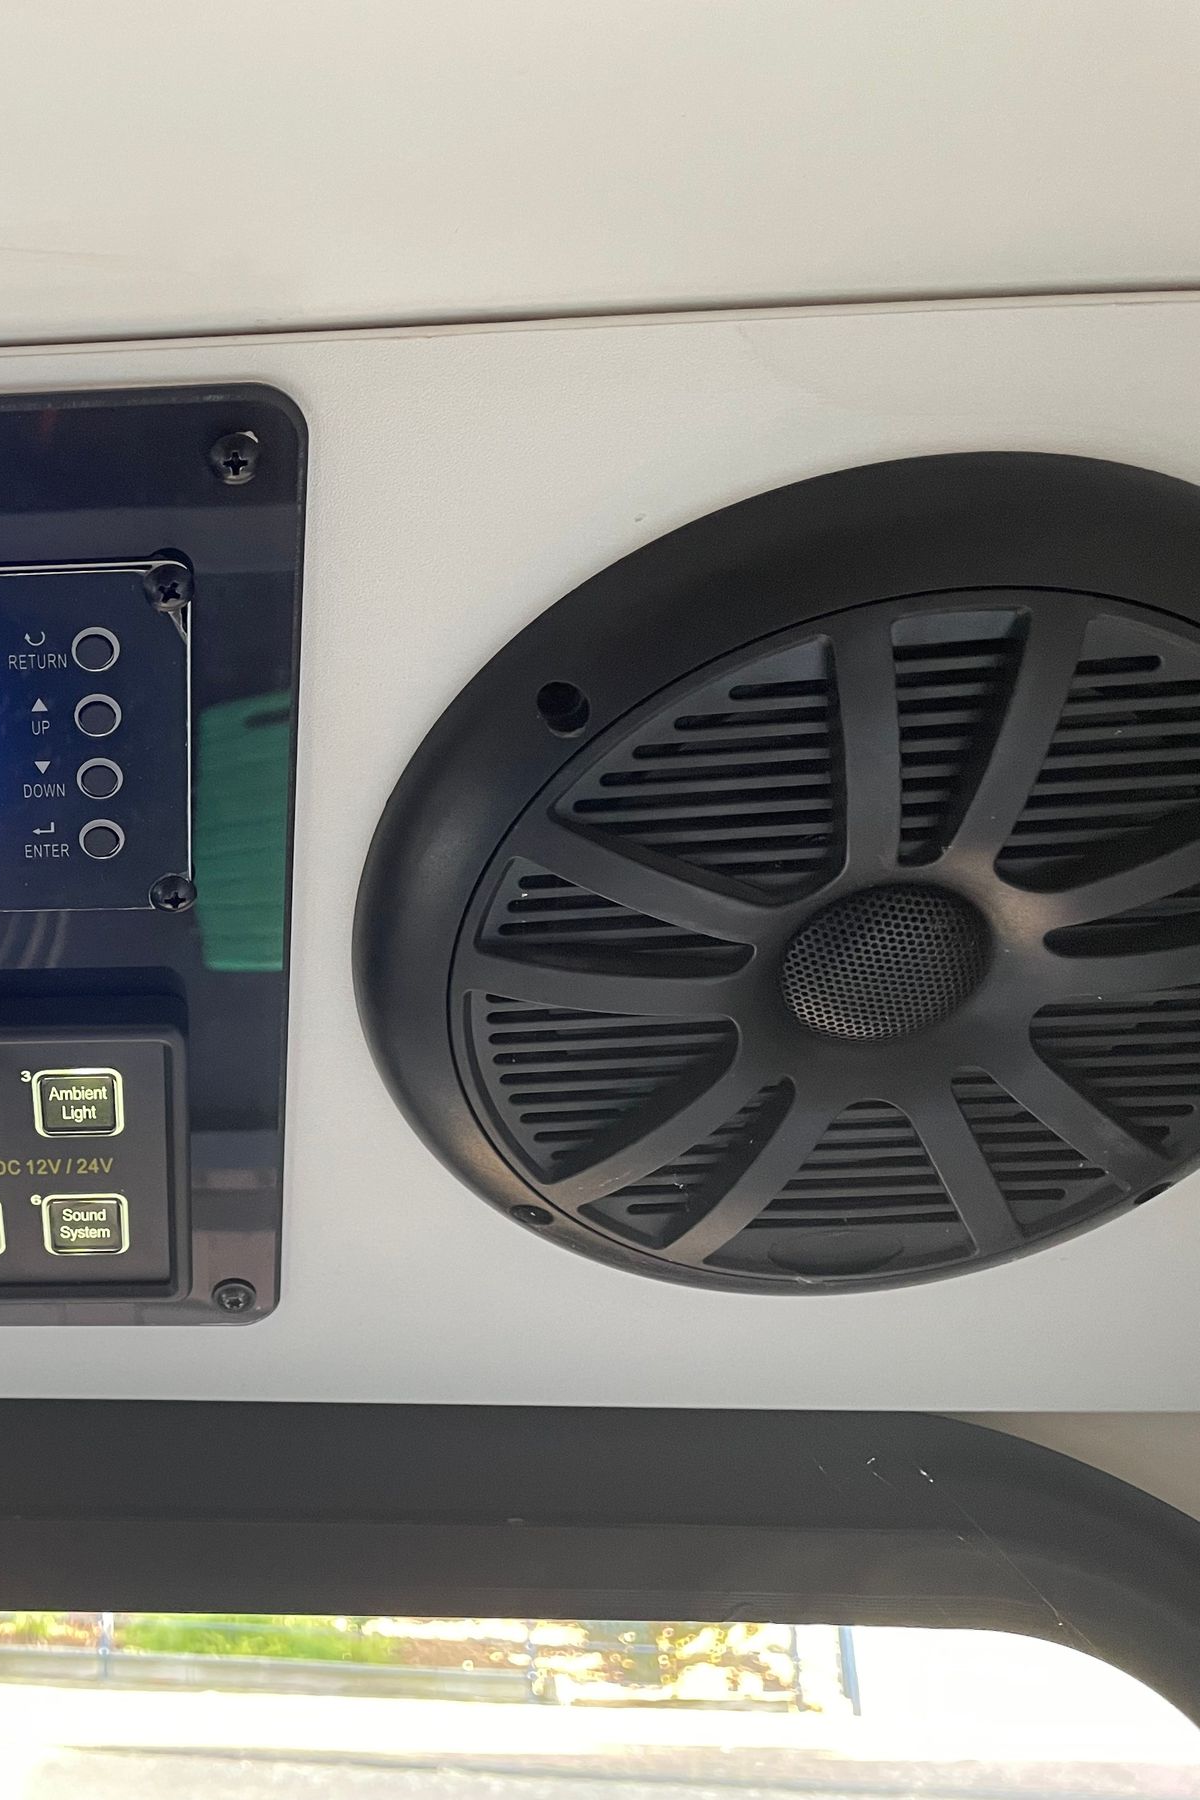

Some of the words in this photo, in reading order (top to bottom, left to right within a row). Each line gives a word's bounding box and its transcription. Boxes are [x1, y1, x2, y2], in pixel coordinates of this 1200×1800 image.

[8, 653, 67, 670] RETURN
[31, 720, 51, 735] UP
[23, 783, 66, 798] DOWN
[24, 843, 69, 858] ENTER
[20, 1071, 31, 1082] 3
[48, 1085, 108, 1102] Ambient
[61, 1105, 97, 1123] Light
[26, 1159, 61, 1175] 12V
[77, 1158, 113, 1174] 24V
[31, 1195, 42, 1206] 6
[62, 1208, 107, 1223] Sound
[60, 1225, 111, 1242] System
